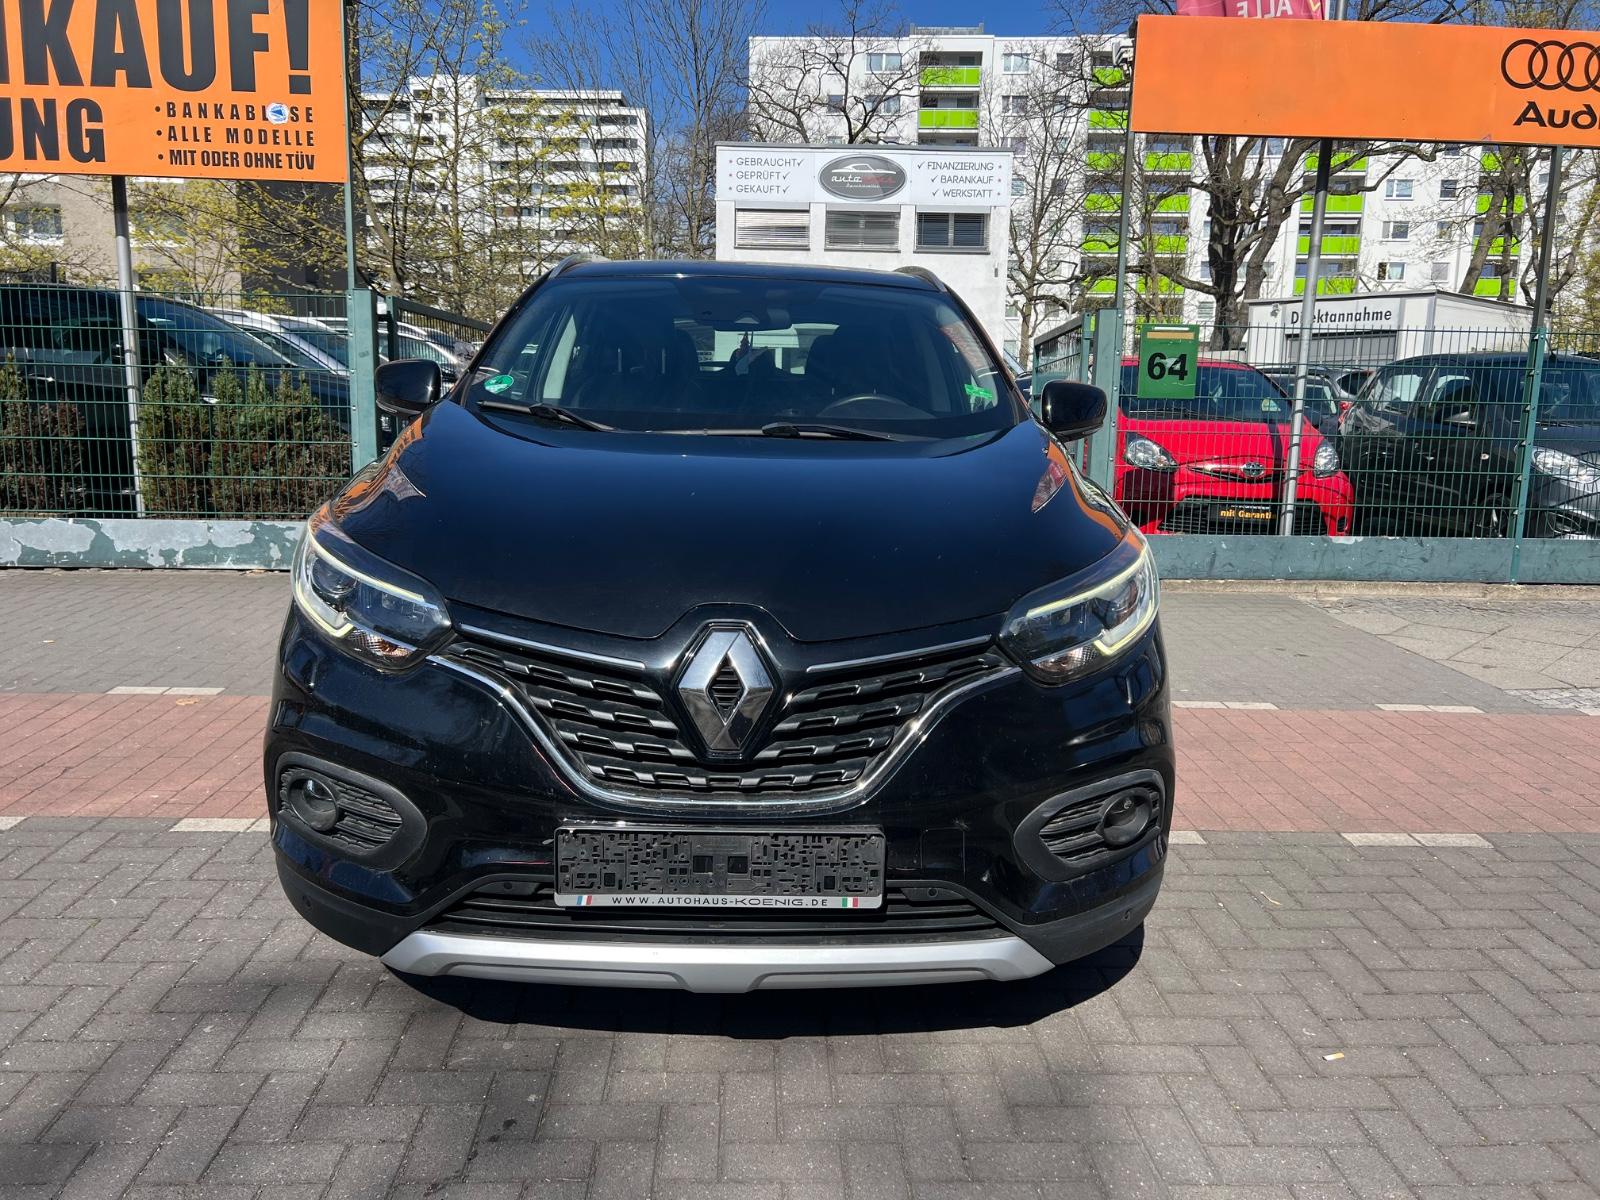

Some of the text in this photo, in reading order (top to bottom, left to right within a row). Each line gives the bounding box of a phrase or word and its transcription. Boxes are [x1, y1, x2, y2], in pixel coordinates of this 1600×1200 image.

[0, 0, 311, 94] KAUF!
[166, 101, 314, 123] BANKABLSE
[1513, 100, 1600, 130] Aud
[167, 125, 315, 147] ALLE MODELLE
[169, 149, 315, 170] MIT ODER OHNE TÜV
[736, 157, 797, 167] GEBRAUCHT
[927, 161, 994, 171] FINANZIERUNG
[736, 169, 781, 180] GEPRÜFT
[940, 174, 994, 184] BARANKAUF
[736, 184, 781, 194] GEKAUFT
[942, 188, 993, 198] WERKSTATT
[1147, 352, 1188, 381] 64
[612, 896, 828, 907] WWW.AUTOHAUS-KOENIG.DE
